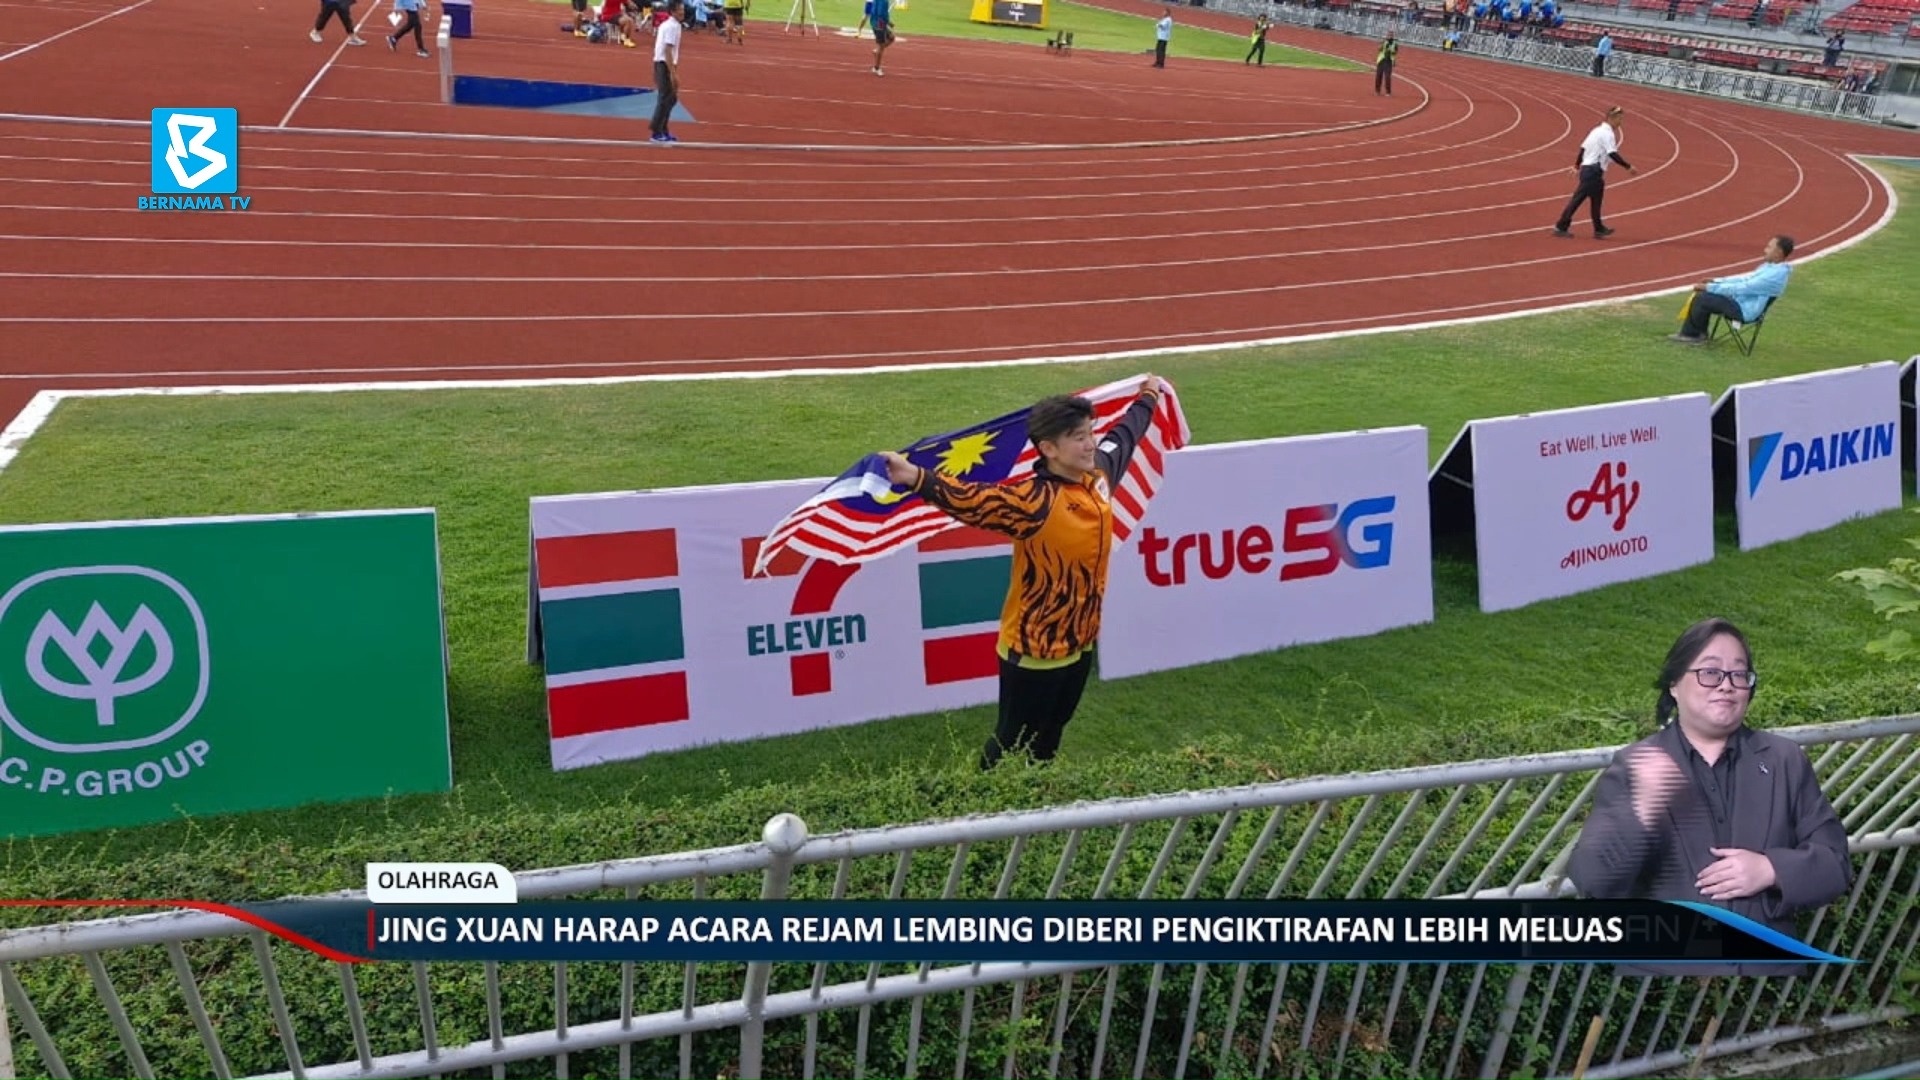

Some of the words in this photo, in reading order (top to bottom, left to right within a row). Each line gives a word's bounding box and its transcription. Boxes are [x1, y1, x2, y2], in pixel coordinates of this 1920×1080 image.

[1540, 440, 1562, 457] Eat
[1601, 431, 1627, 448] Live
[1780, 422, 1895, 481] DAIKIN
[1560, 535, 1648, 569] AJINOMOTO
